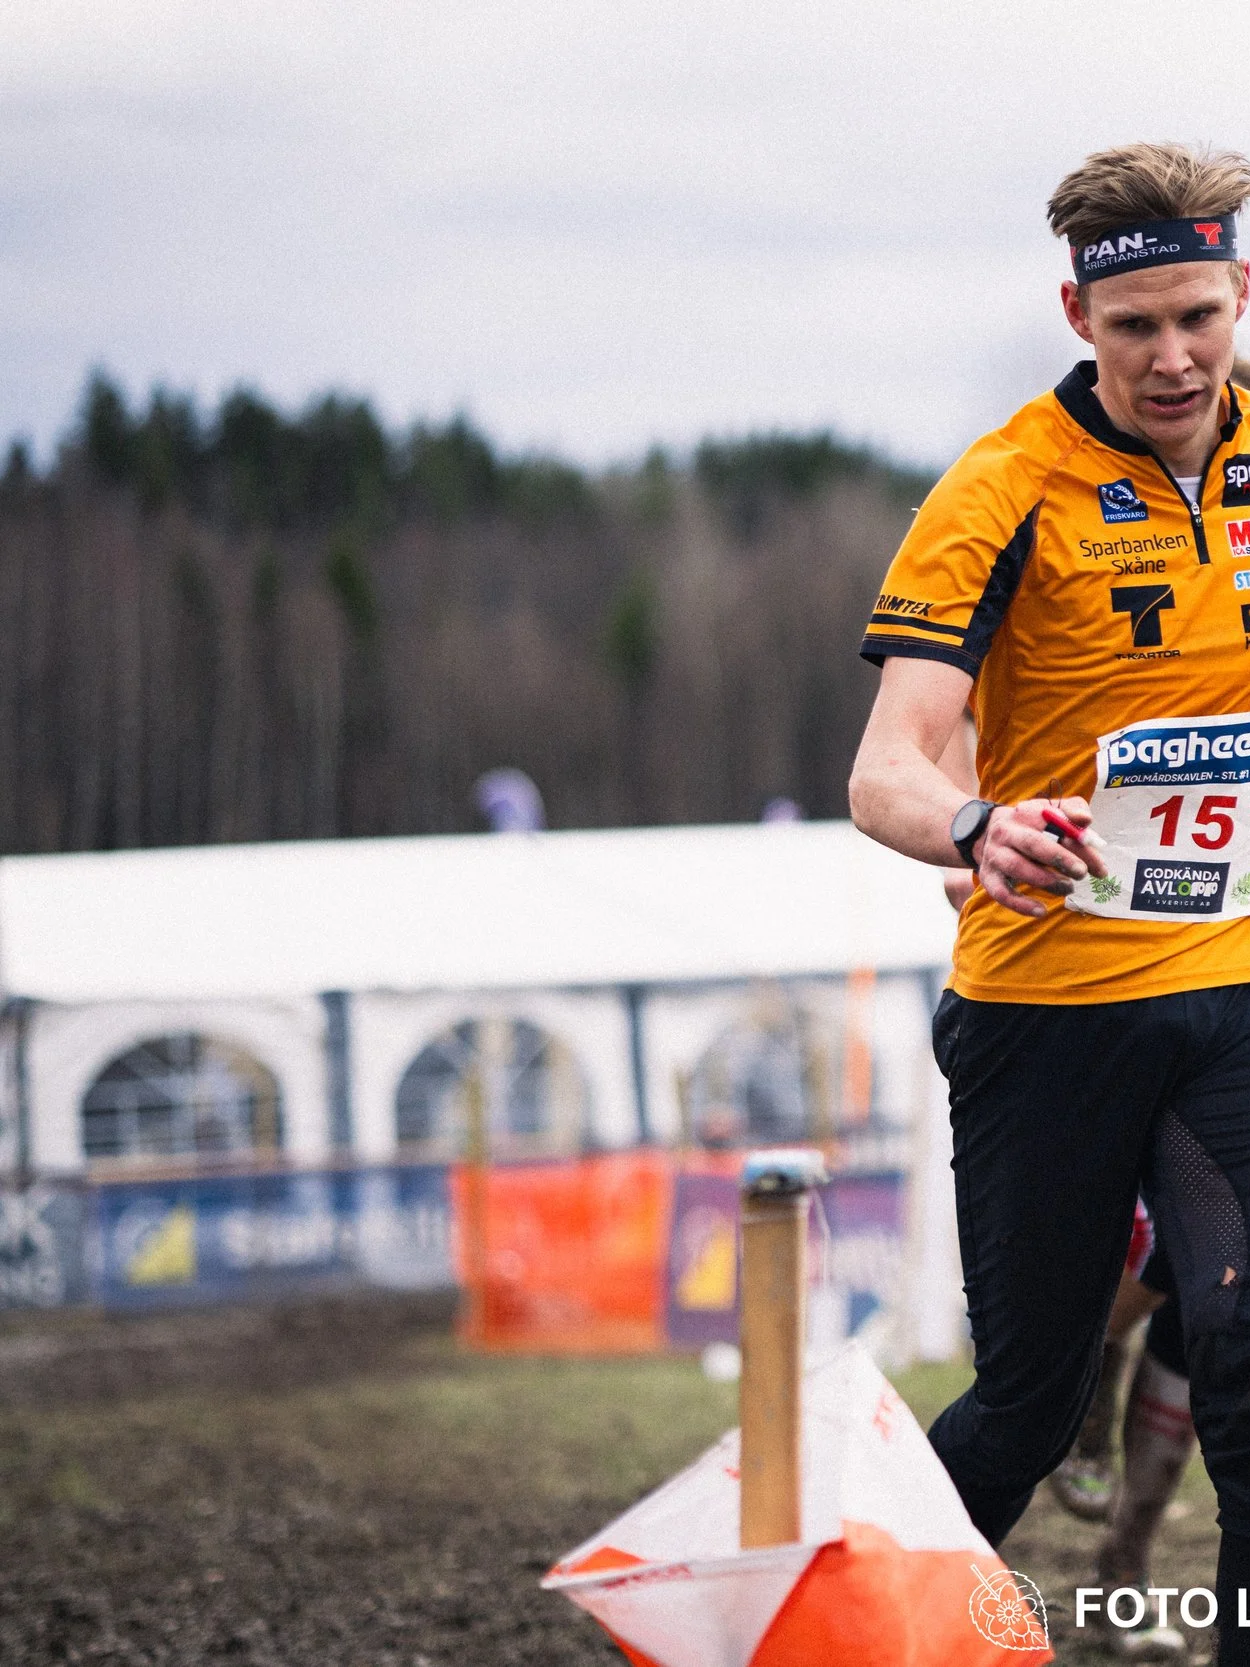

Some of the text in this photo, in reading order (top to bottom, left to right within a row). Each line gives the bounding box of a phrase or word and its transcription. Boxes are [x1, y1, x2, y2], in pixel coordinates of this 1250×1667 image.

[1083, 232, 1158, 263] PAN-
[1085, 243, 1181, 272] KRISTIANSTAD
[1079, 534, 1188, 560] Sparbanken
[1111, 556, 1166, 576] Skåne
[1115, 650, 1181, 660] T-KARTOR
[1124, 771, 1213, 784] KOLMÅRDSKAVLEN
[1221, 772, 1238, 781] STL
[1239, 771, 1250, 779] #1
[1150, 795, 1238, 851] 15
[1143, 867, 1220, 881] GODKÄNDA
[1141, 880, 1218, 897] AVLOPP
